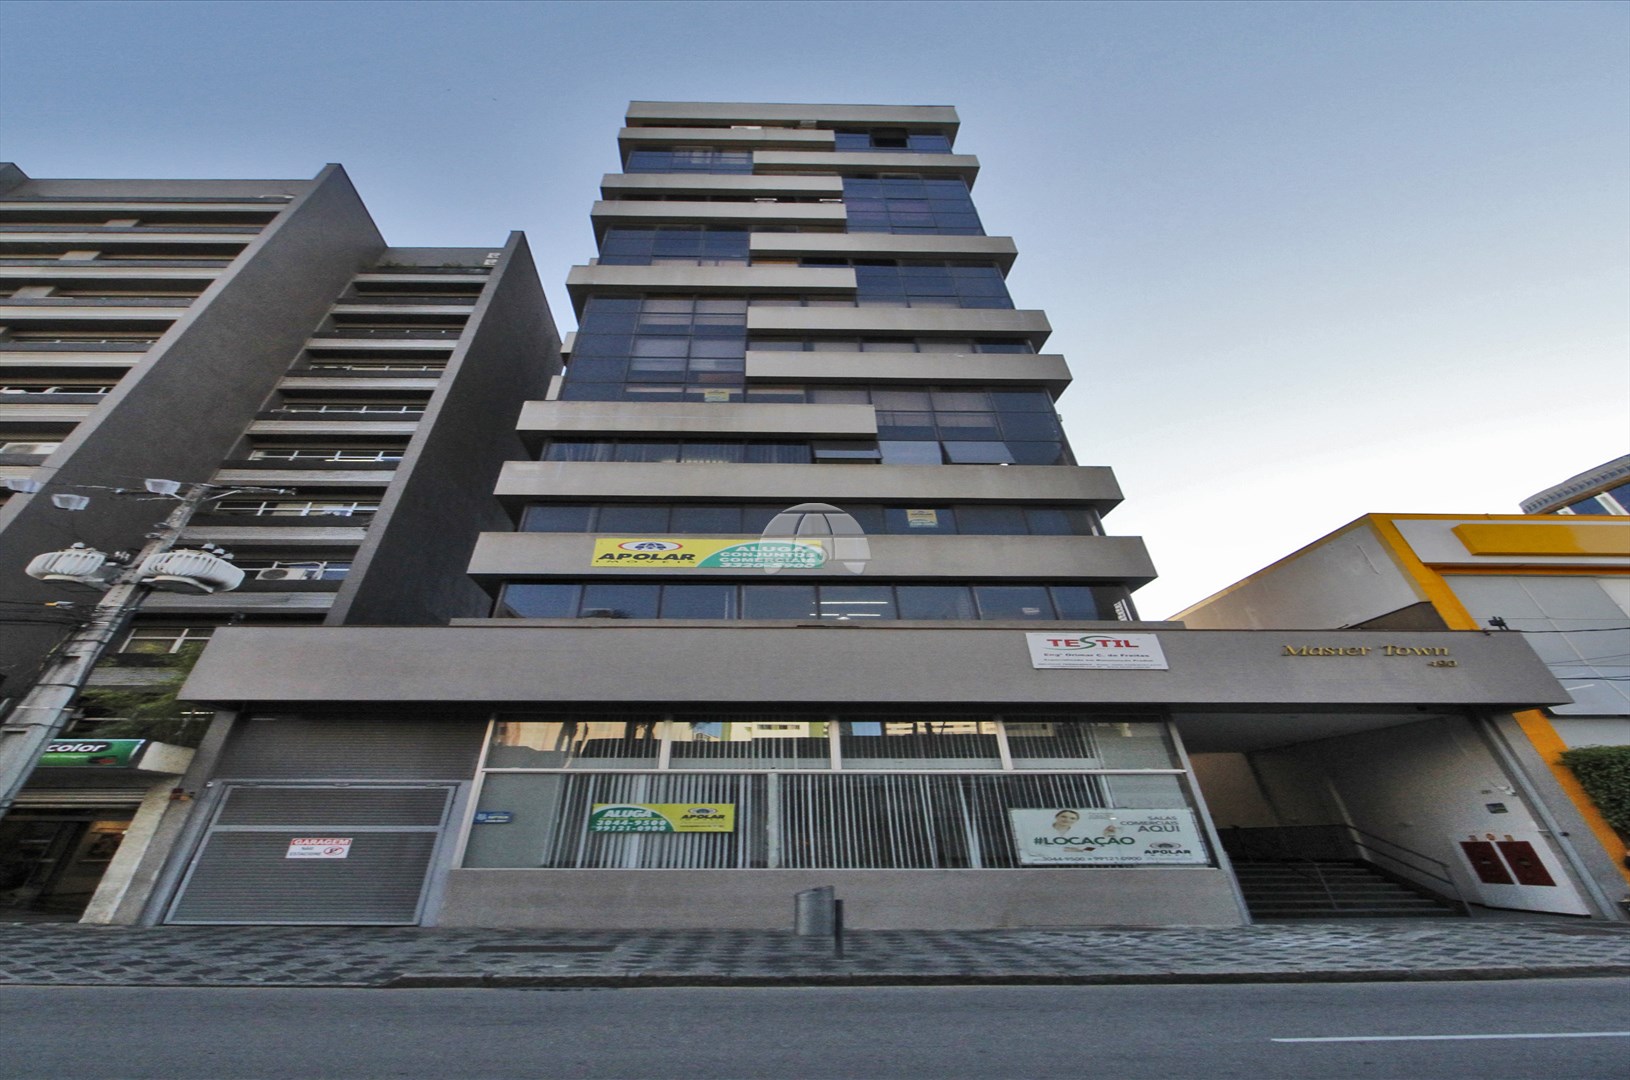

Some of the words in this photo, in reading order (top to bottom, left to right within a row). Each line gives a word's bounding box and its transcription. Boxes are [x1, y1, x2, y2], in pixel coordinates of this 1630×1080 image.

[598, 553, 696, 561] APOLAR
[1045, 636, 1140, 650] TESTIL
[1282, 645, 1372, 656] Master
[1381, 645, 1449, 656] Town
[1034, 835, 1136, 847] #LOCAÇÃO
